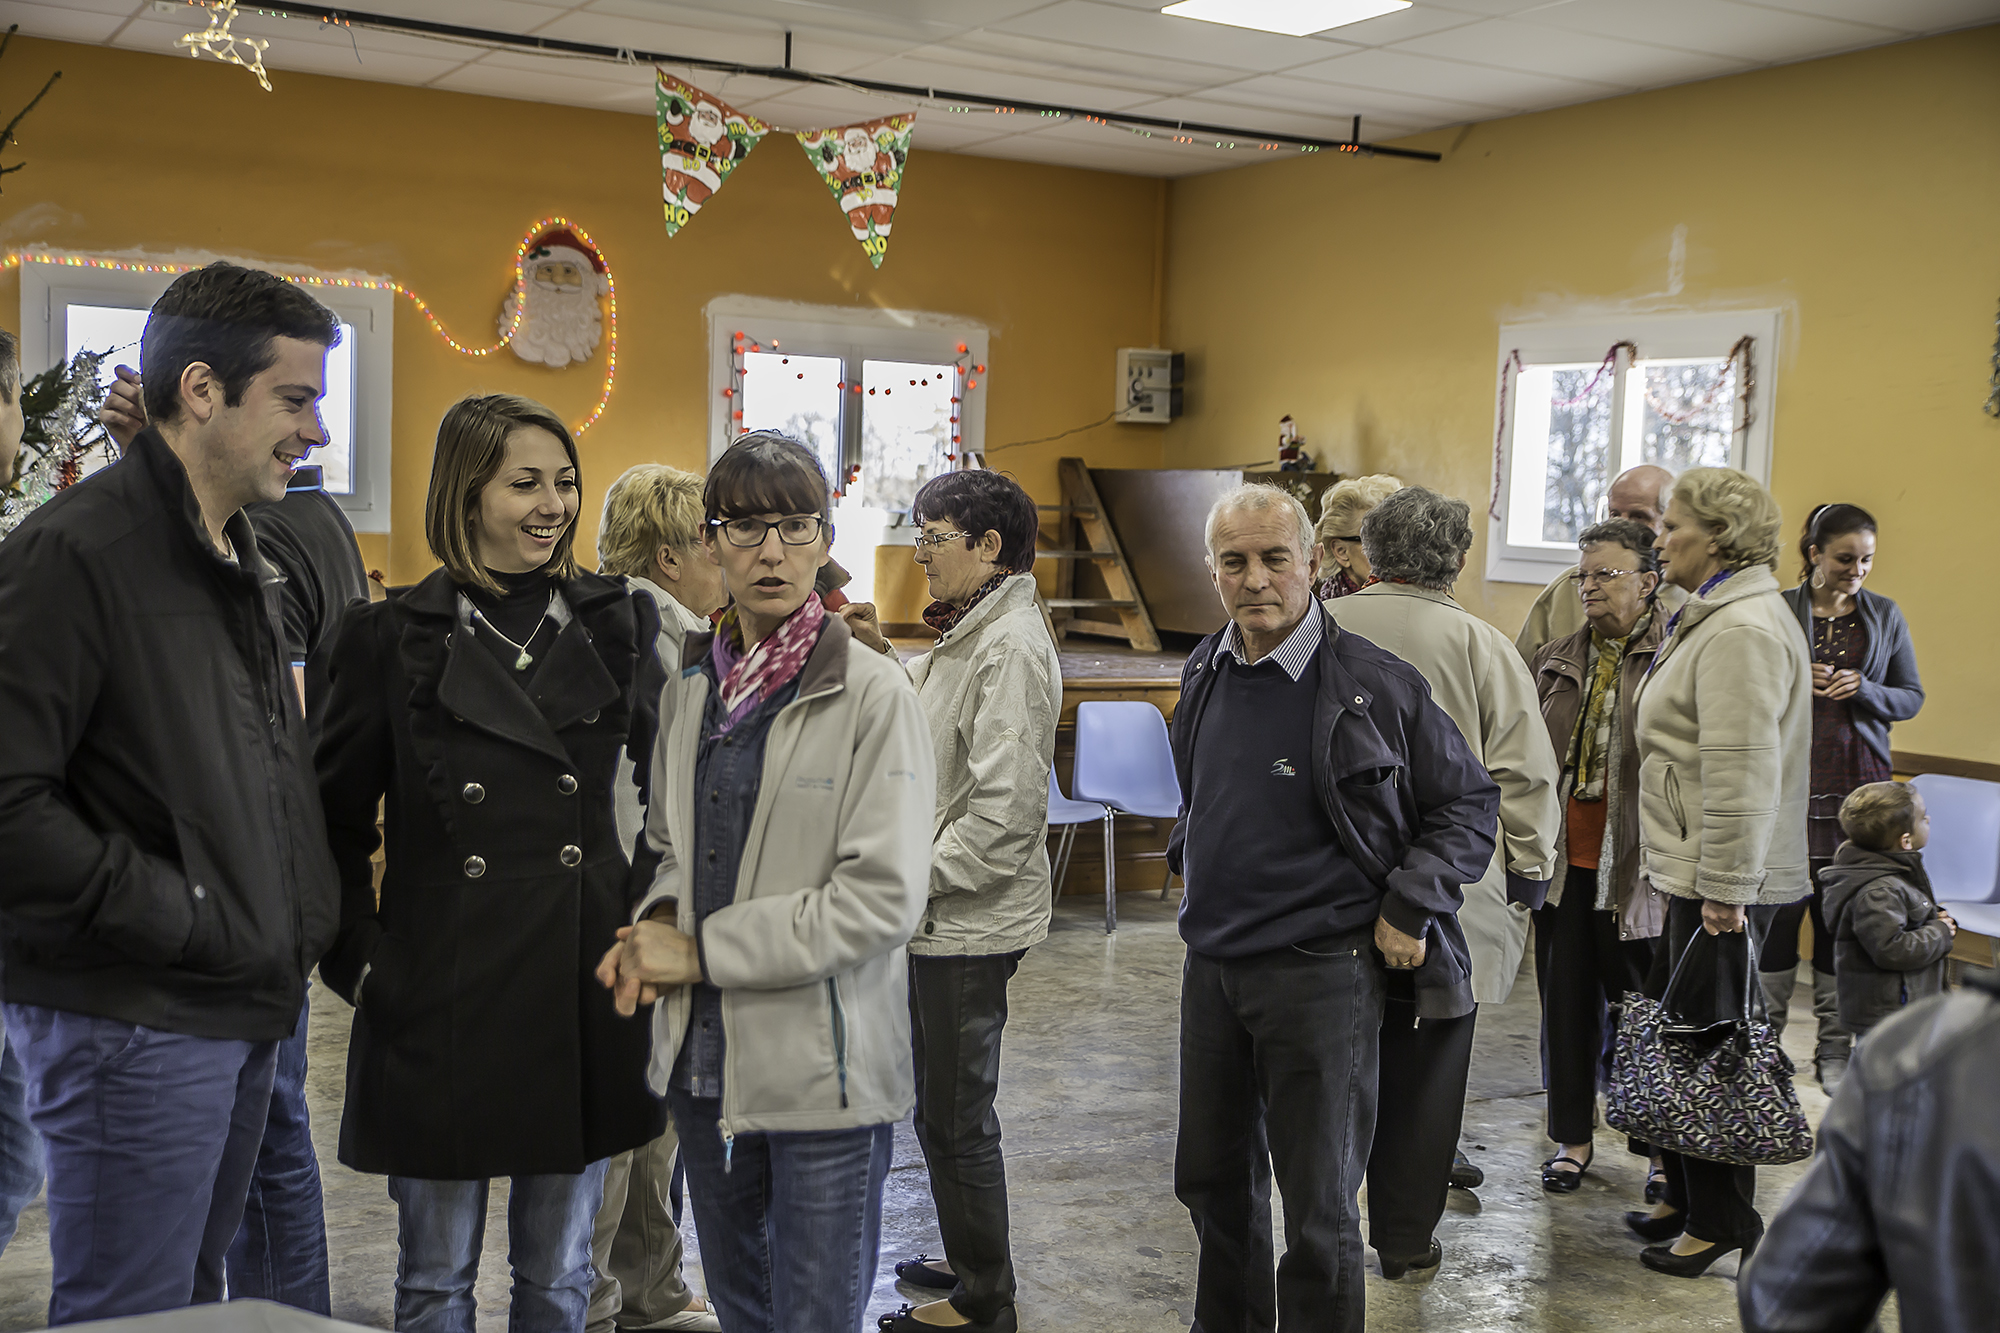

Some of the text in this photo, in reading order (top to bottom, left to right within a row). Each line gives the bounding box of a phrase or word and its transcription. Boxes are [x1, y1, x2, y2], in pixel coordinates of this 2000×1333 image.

[676, 84, 693, 102] HO
[729, 122, 747, 136] HO
[747, 115, 763, 133] HO
[891, 116, 907, 133] HO
[658, 123, 674, 144] HO
[822, 128, 838, 141] HO
[878, 130, 895, 146] HO
[682, 157, 701, 171] HO
[714, 158, 731, 174] HO
[826, 173, 842, 190] HO
[856, 187, 873, 203] HO
[664, 203, 690, 228] HO
[861, 235, 888, 257] HO
